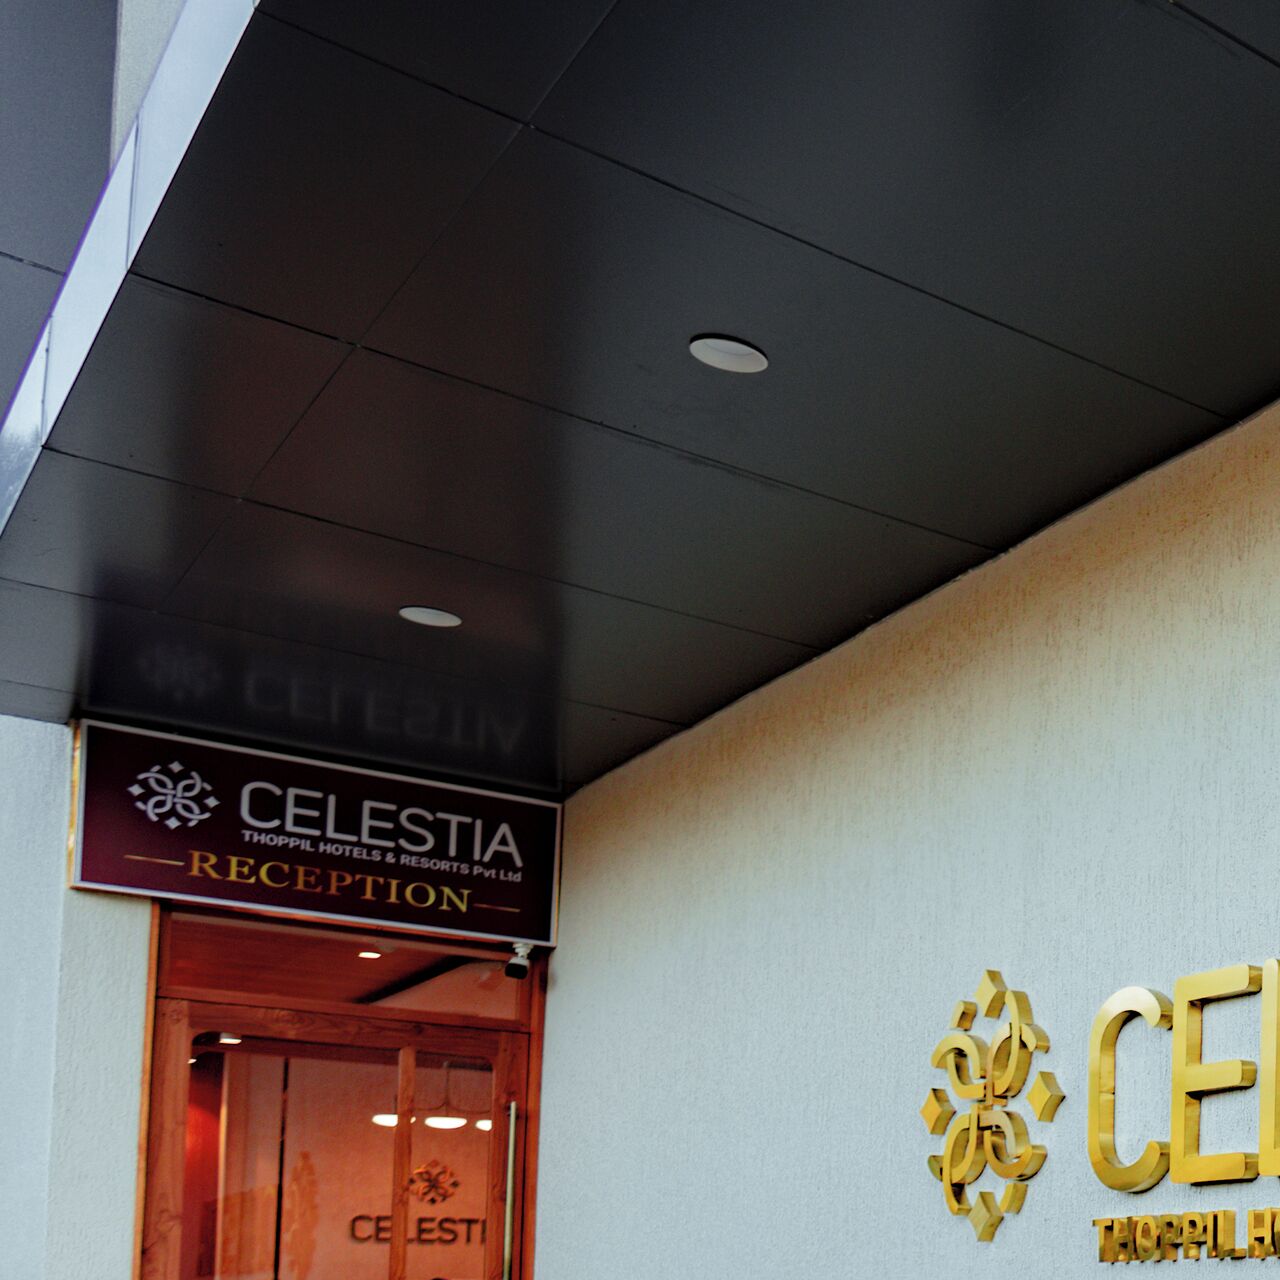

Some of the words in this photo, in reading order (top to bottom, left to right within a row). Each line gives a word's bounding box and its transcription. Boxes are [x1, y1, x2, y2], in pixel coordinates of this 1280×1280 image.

[240, 781, 523, 868] CELESTIA
[188, 850, 472, 914] RECEPTION
[241, 829, 315, 852] THOPPIL
[319, 842, 382, 861] HOTELS
[384, 851, 396, 864] &
[400, 853, 470, 875] RESORTS
[472, 864, 497, 879] Pvt
[499, 869, 523, 883] Ltd
[350, 1214, 487, 1244] CEESTI
[1092, 1209, 1247, 1262] THOPPIL
